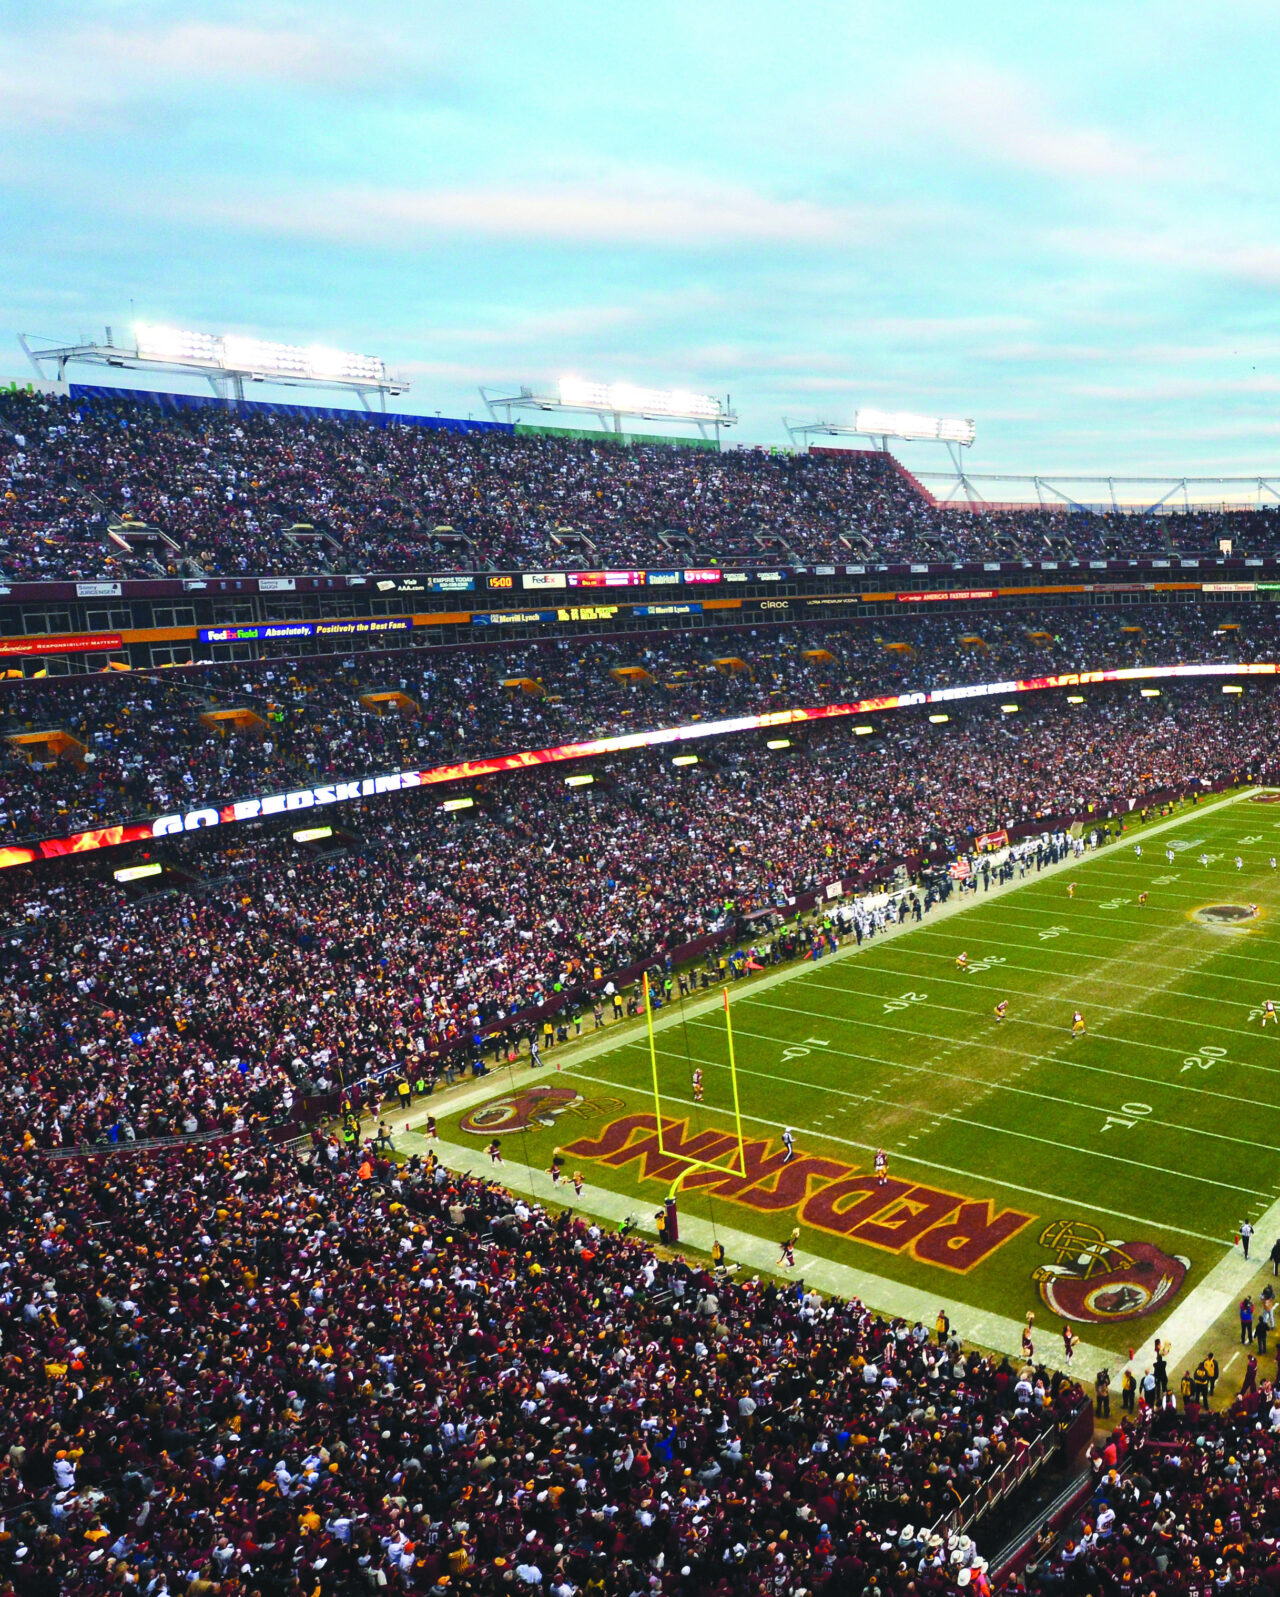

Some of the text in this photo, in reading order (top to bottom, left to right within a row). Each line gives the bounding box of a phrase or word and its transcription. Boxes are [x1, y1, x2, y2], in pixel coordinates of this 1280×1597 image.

[489, 577, 512, 587] 15:00
[532, 576, 555, 584] FedEx
[499, 613, 540, 623] Merrill Lynch
[208, 628, 258, 640] FedExField
[316, 621, 407, 634] Positively the Best Fans.
[152, 770, 422, 837] GO REDSKINS
[1039, 926, 1069, 938] 40
[968, 955, 1006, 972] 30
[884, 991, 928, 1011] 20
[782, 1036, 830, 1058] 10
[1183, 1046, 1228, 1070] 20
[1106, 1103, 1153, 1129] 10
[560, 1112, 1040, 1275] REDSKINS
[866, 1488, 877, 1500] 10
[428, 1532, 438, 1544] 10
